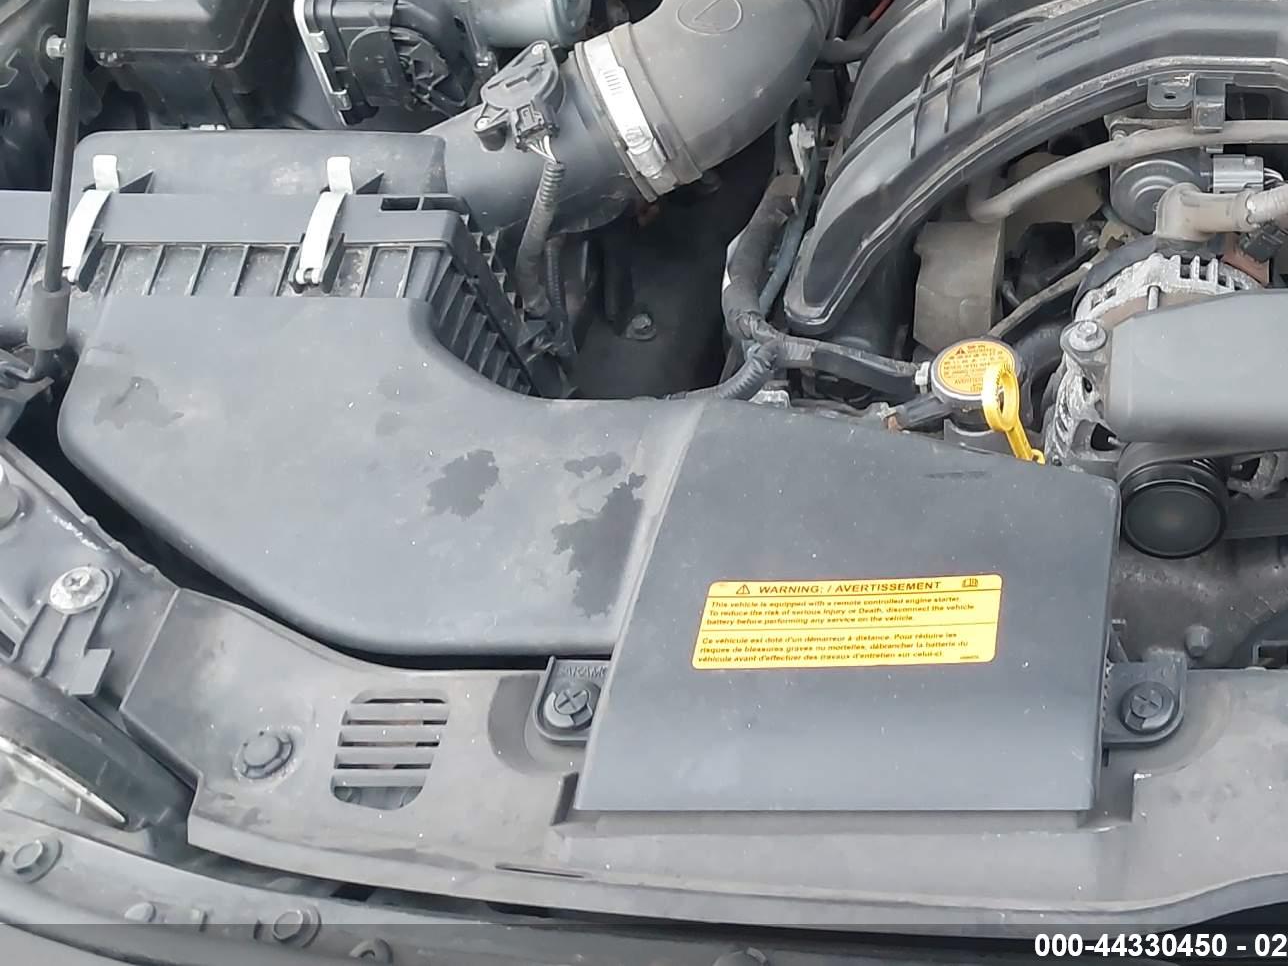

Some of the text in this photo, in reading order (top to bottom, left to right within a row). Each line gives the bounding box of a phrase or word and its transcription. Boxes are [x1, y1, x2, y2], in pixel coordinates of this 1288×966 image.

[834, 581, 942, 594] AVERTISSEMENT
[769, 600, 807, 609] equipped
[905, 597, 932, 605] engine
[886, 605, 929, 613] disconnect
[706, 618, 733, 626] battery
[764, 618, 808, 626] performing
[786, 645, 813, 653] graves
[925, 640, 956, 648] batterie
